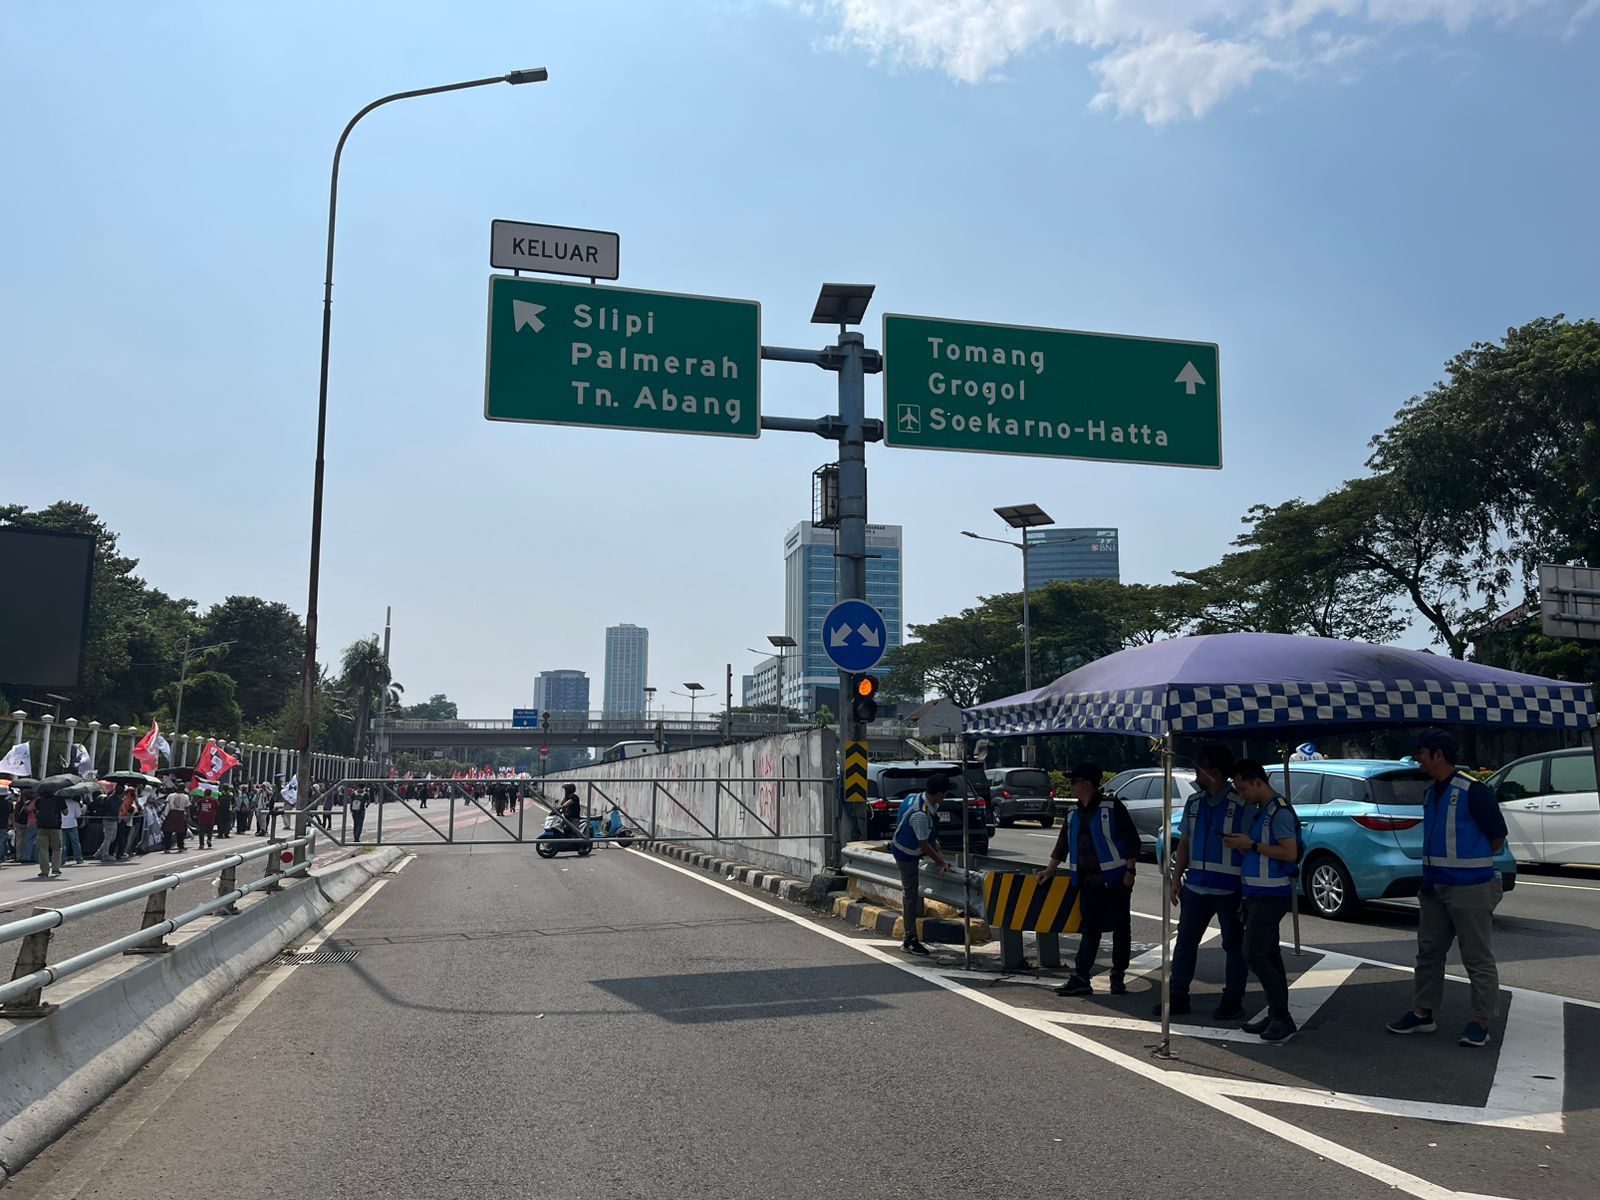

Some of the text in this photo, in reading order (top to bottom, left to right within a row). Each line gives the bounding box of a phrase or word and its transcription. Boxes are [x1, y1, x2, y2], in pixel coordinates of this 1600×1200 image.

[512, 237, 599, 264] KELUAR
[572, 304, 655, 337] Slipi
[571, 342, 739, 380] Palmerah
[927, 337, 1045, 374] Tomang
[571, 380, 742, 424] Tn. Abang
[928, 372, 1026, 405] Grogol
[929, 407, 1169, 447] Soekarno-Hatta
[1100, 543, 1116, 552] BNI
